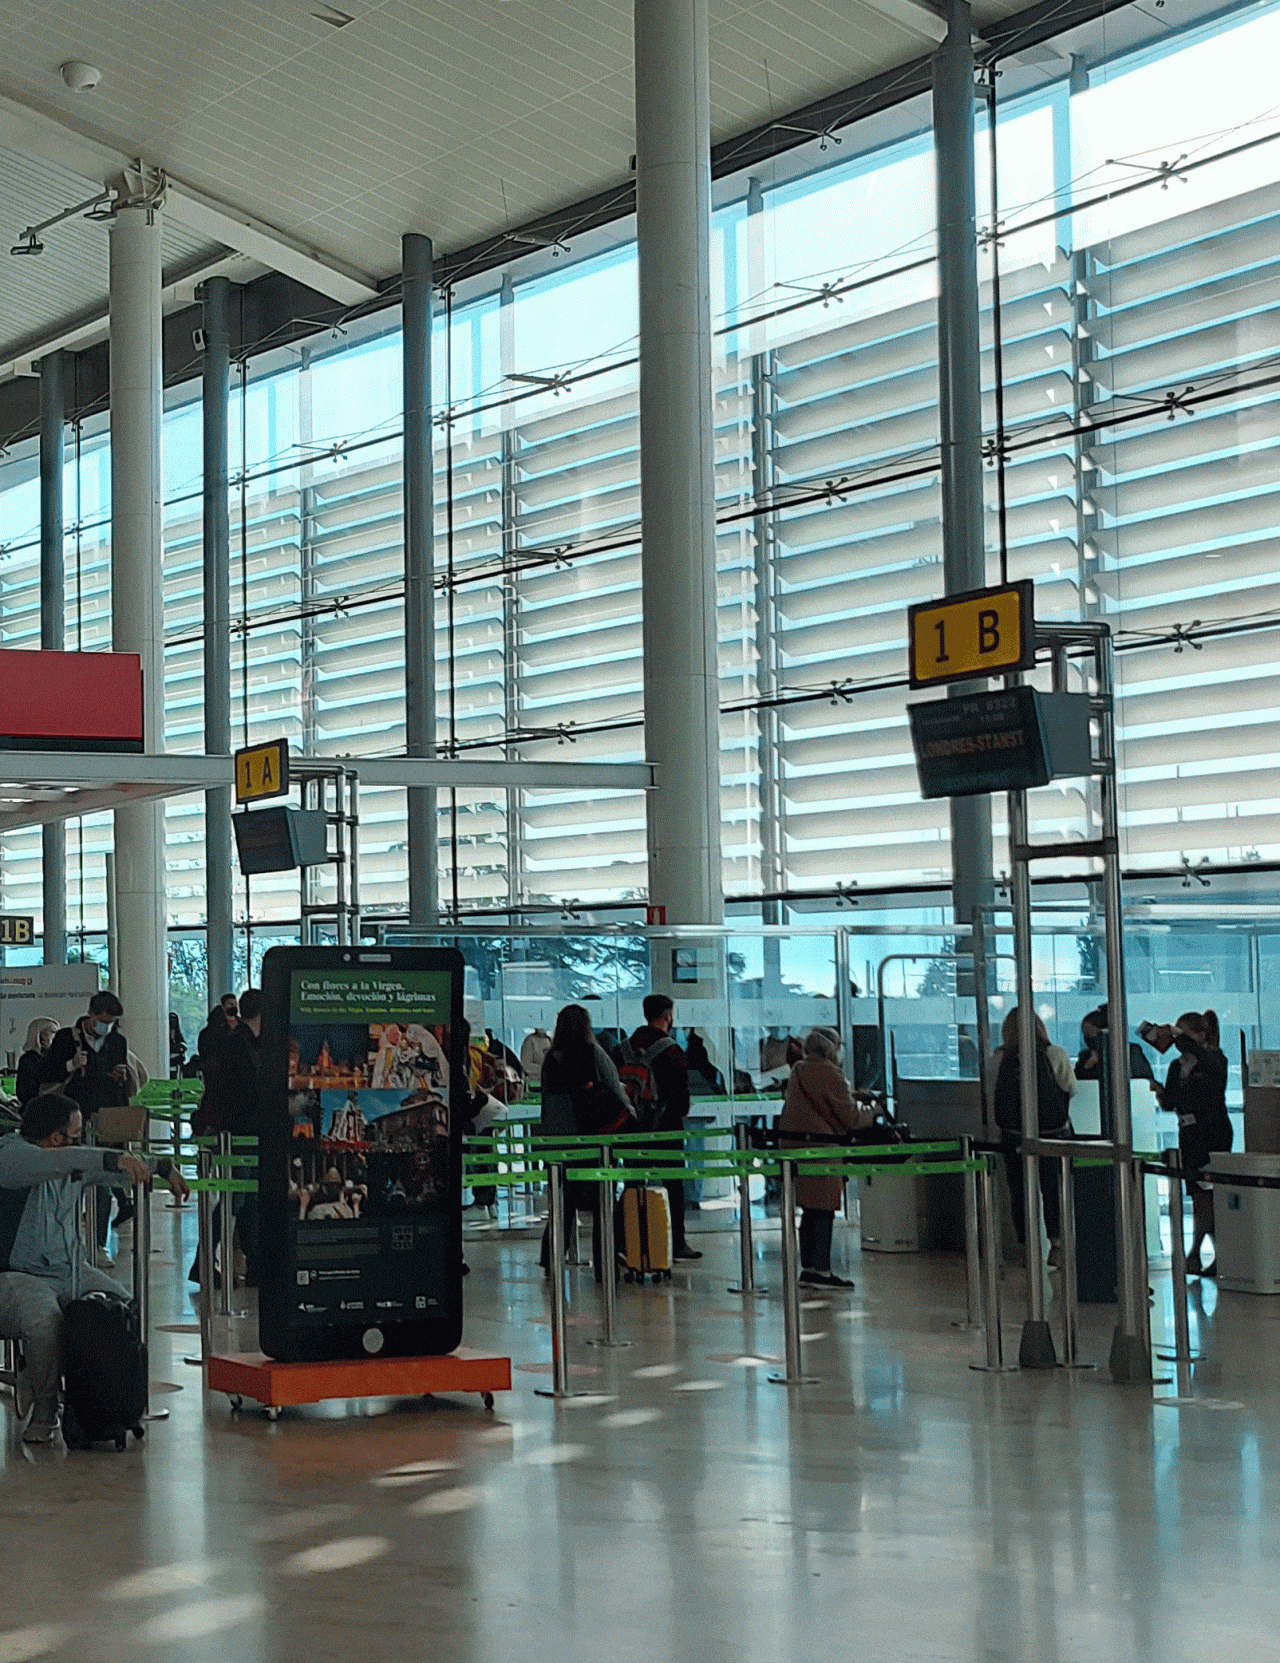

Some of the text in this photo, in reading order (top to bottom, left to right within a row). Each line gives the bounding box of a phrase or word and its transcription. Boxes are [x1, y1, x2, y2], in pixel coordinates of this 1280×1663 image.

[1, 919, 31, 942] 1B
[300, 980, 320, 991] Con
[322, 980, 350, 991] flores
[352, 983, 358, 991] a
[360, 981, 370, 991] la
